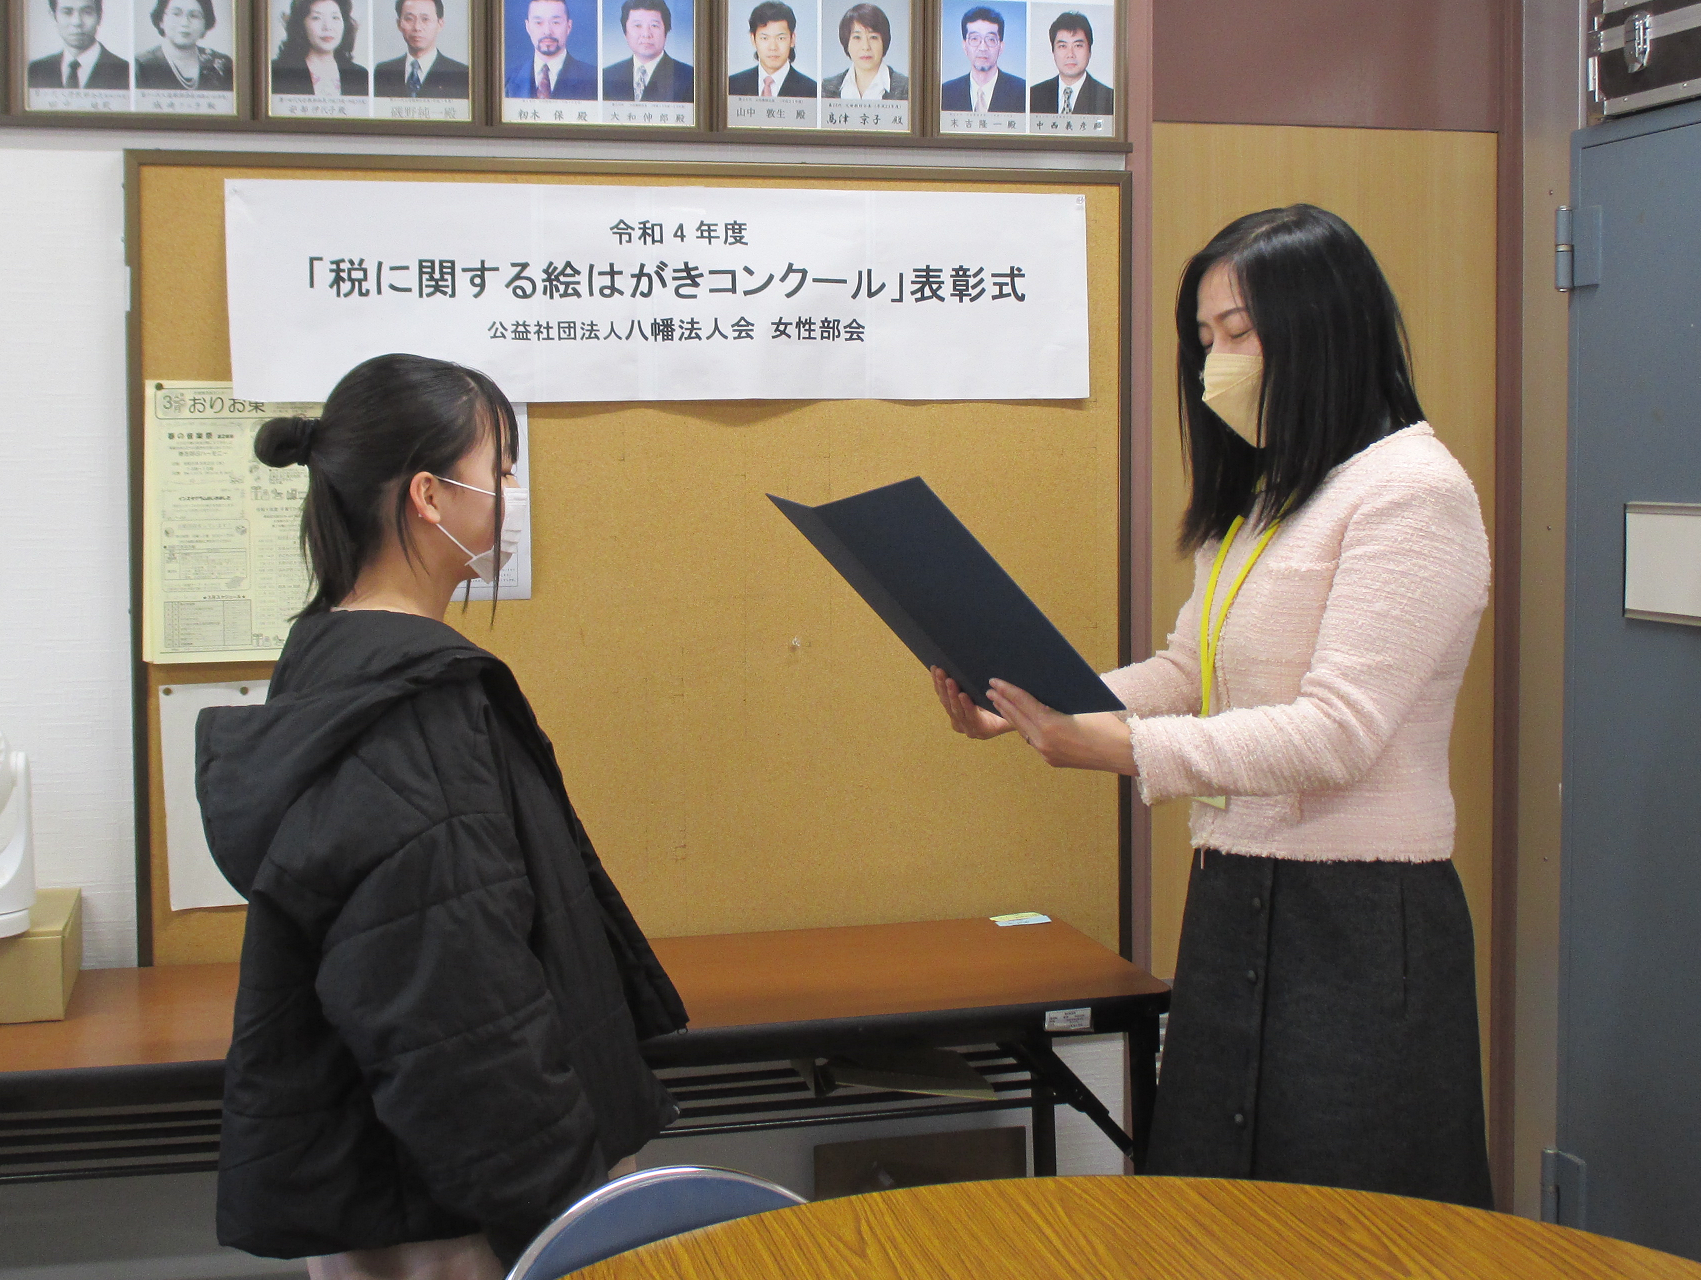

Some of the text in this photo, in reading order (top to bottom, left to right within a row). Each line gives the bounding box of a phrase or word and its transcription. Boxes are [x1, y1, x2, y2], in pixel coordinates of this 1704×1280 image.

[736, 107, 756, 118] 山中
[308, 256, 1026, 304] 「税に関する絵はがきコンクール」表彰式
[487, 315, 866, 342] 公益社団法人八幡法人会 女性部会
